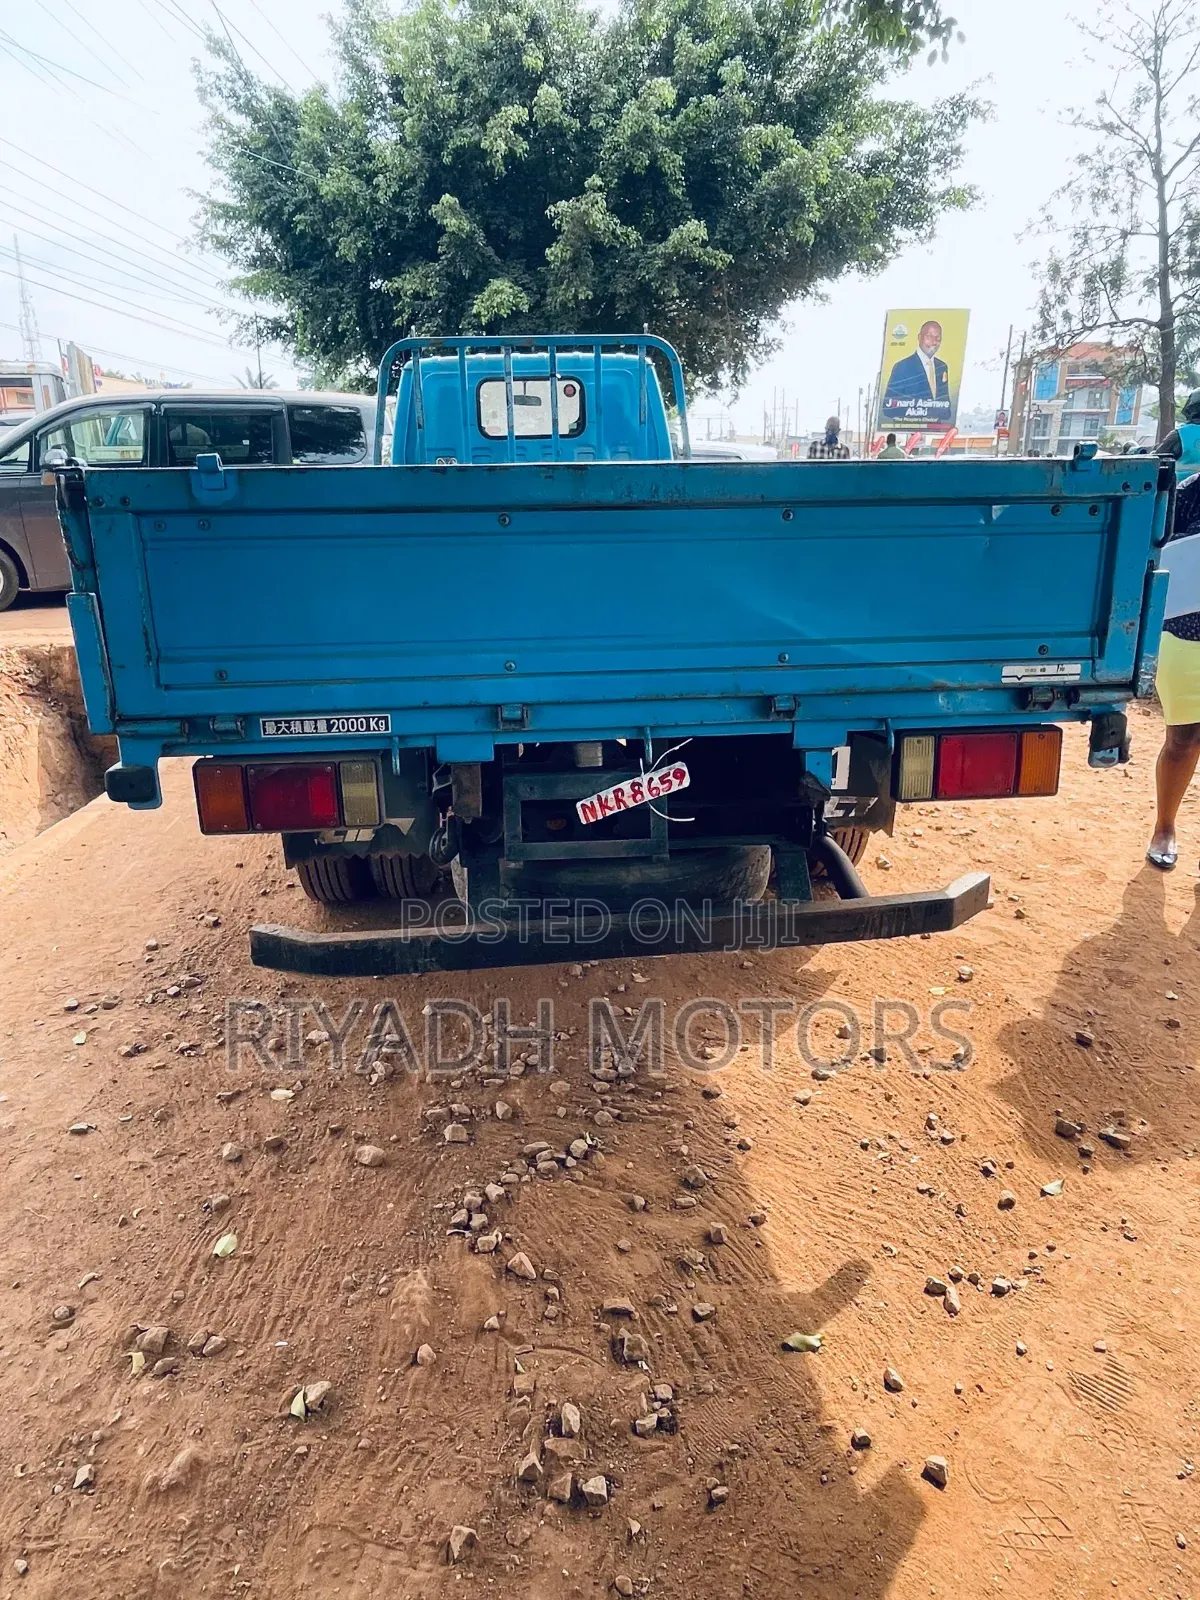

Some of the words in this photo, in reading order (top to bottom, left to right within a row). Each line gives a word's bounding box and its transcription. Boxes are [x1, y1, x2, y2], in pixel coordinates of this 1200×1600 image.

[264, 720, 327, 735] 最大積載量
[330, 718, 367, 733] 2000
[369, 717, 386, 732] Kg
